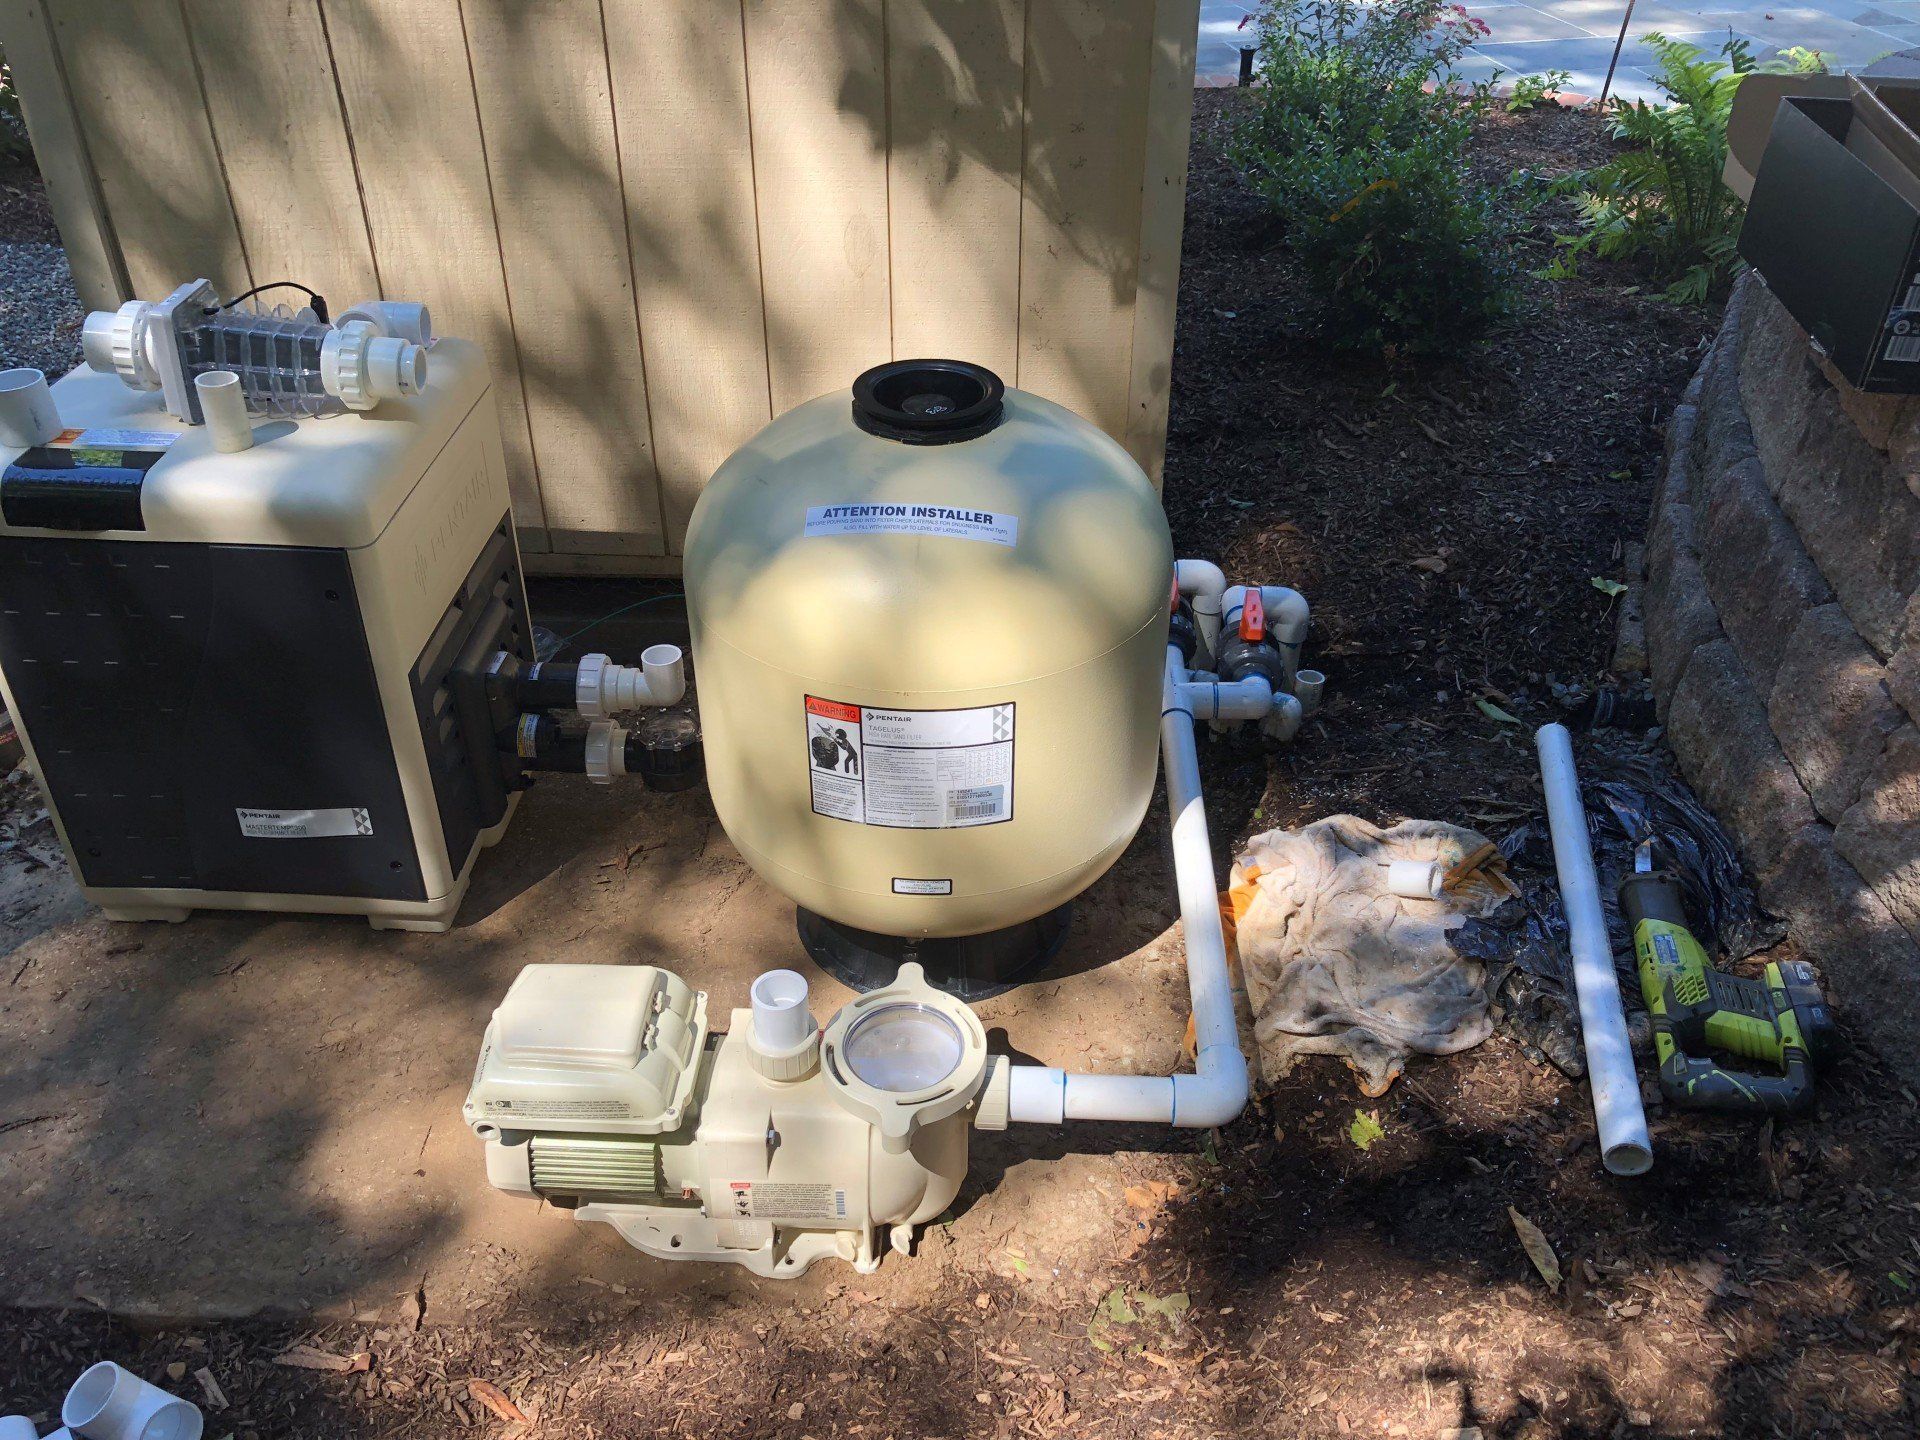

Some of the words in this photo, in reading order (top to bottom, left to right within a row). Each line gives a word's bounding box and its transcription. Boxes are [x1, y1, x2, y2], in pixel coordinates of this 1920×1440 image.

[823, 506, 907, 519] ATTENTION
[911, 506, 994, 525] INSTALLER
[951, 521, 980, 530] SNUGNESS
[818, 704, 856, 719] WARNING
[876, 714, 912, 722] PENTAIR
